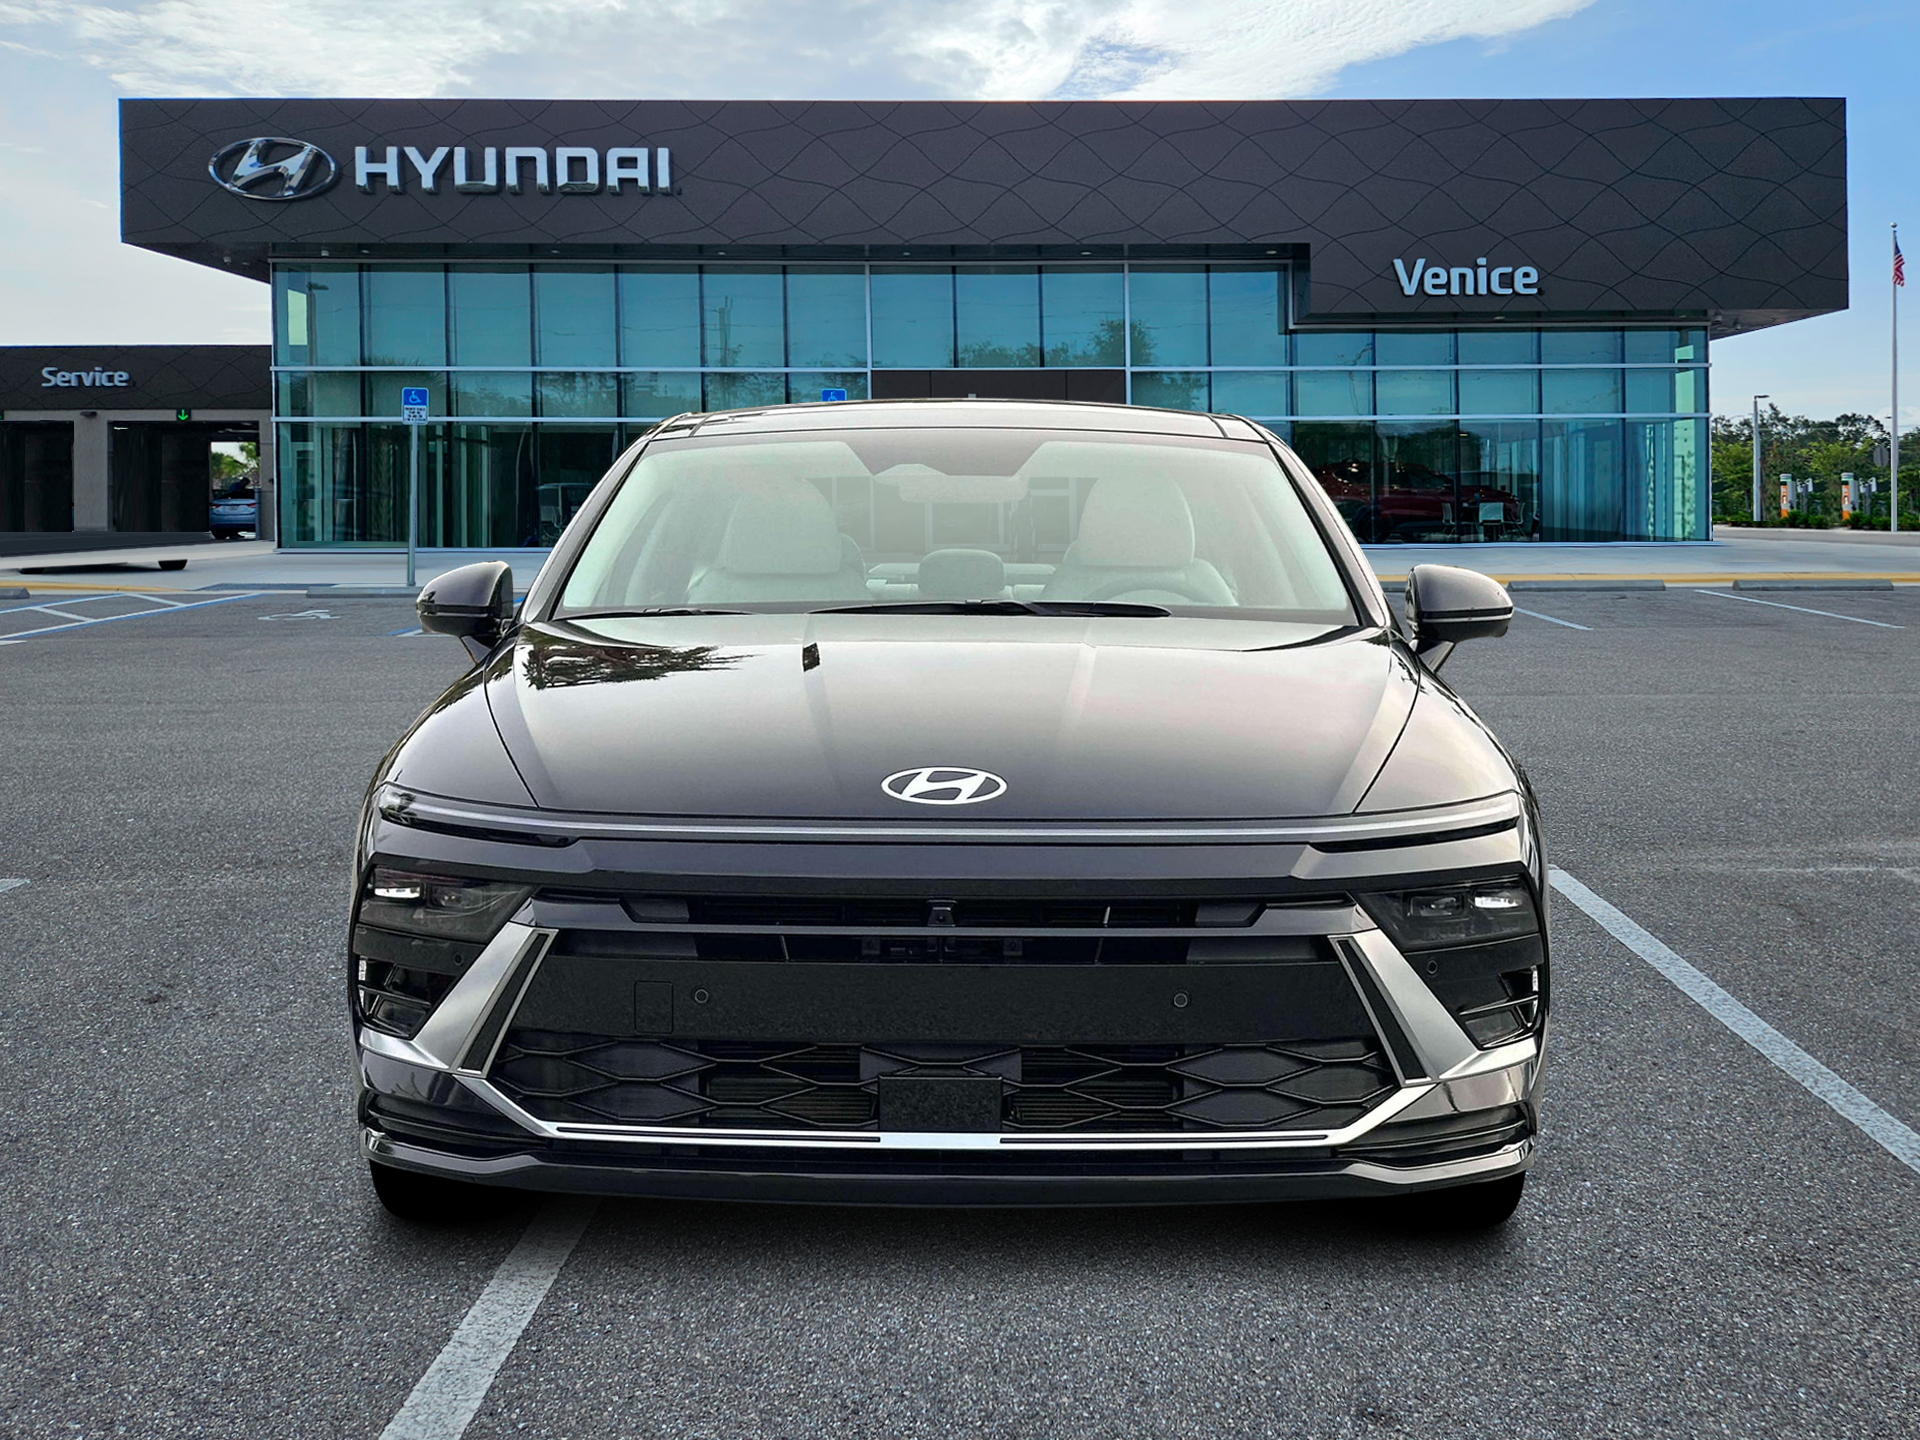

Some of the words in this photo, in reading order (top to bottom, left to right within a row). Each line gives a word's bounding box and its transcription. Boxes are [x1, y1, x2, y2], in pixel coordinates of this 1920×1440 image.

[354, 146, 674, 194] HYUNDAI
[1393, 257, 1538, 296] Venice
[41, 366, 130, 387] Service
